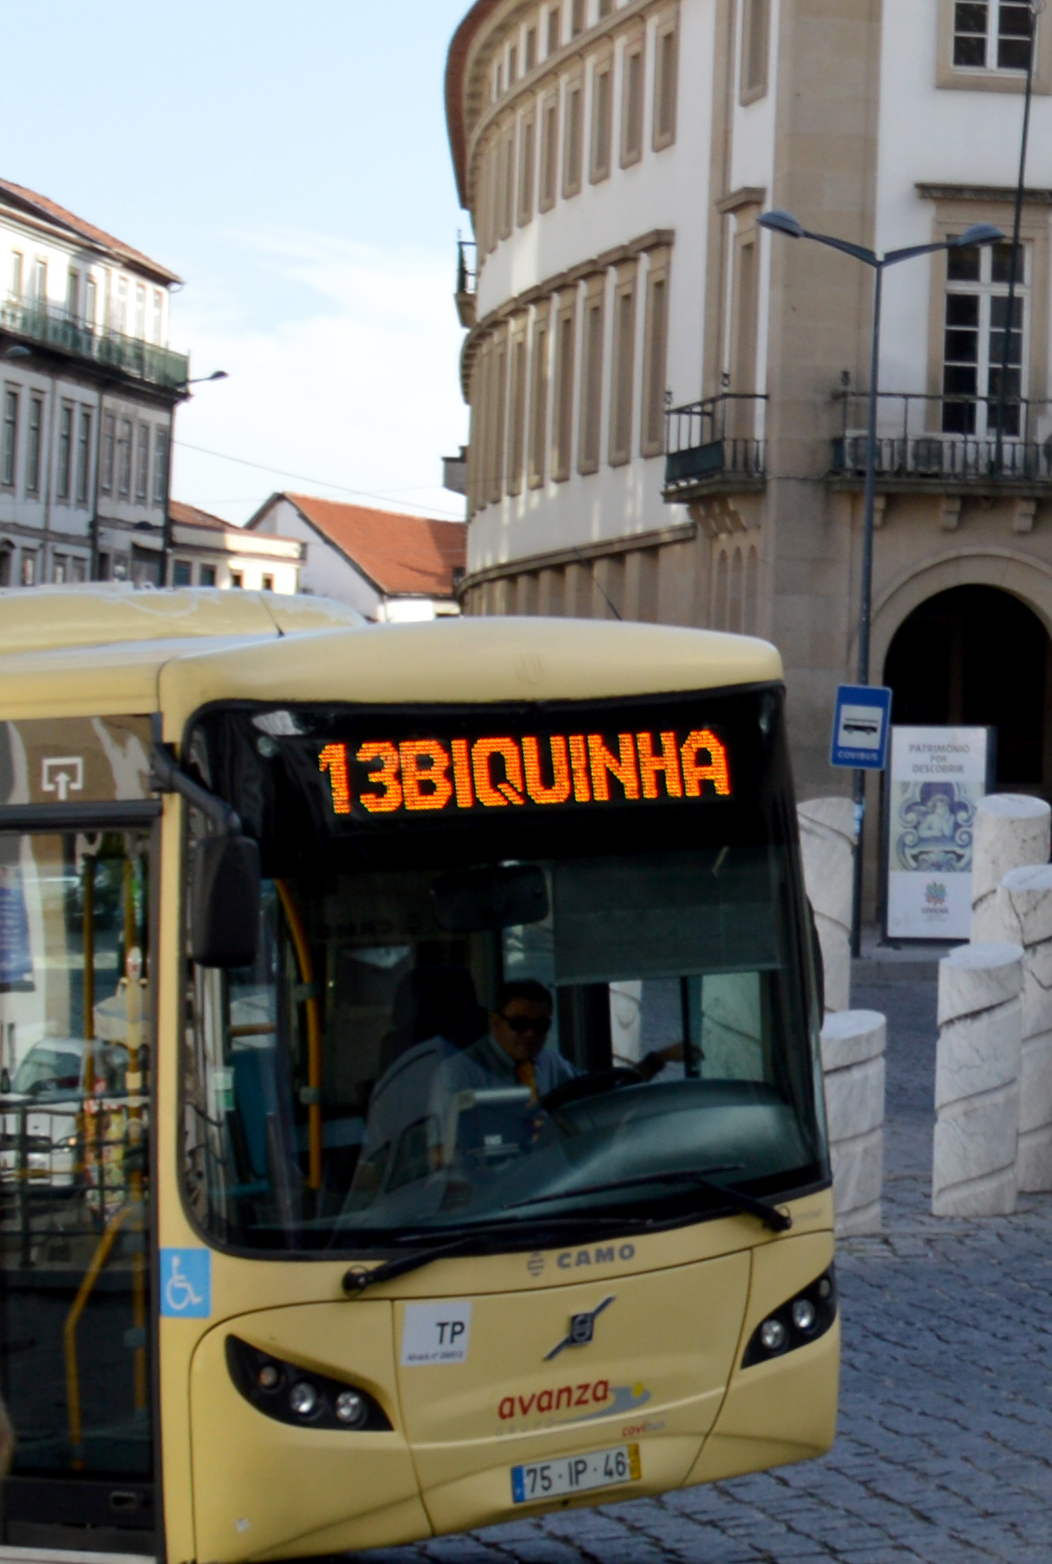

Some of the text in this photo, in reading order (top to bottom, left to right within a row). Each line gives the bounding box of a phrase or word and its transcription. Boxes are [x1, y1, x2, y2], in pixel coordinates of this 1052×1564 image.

[837, 750, 878, 762] COVIBUS
[930, 755, 947, 763] POR
[912, 764, 964, 774] DESCOBRIR
[556, 1244, 636, 1269] CAMO
[436, 1320, 466, 1345] TP
[497, 1379, 609, 1420] avanza
